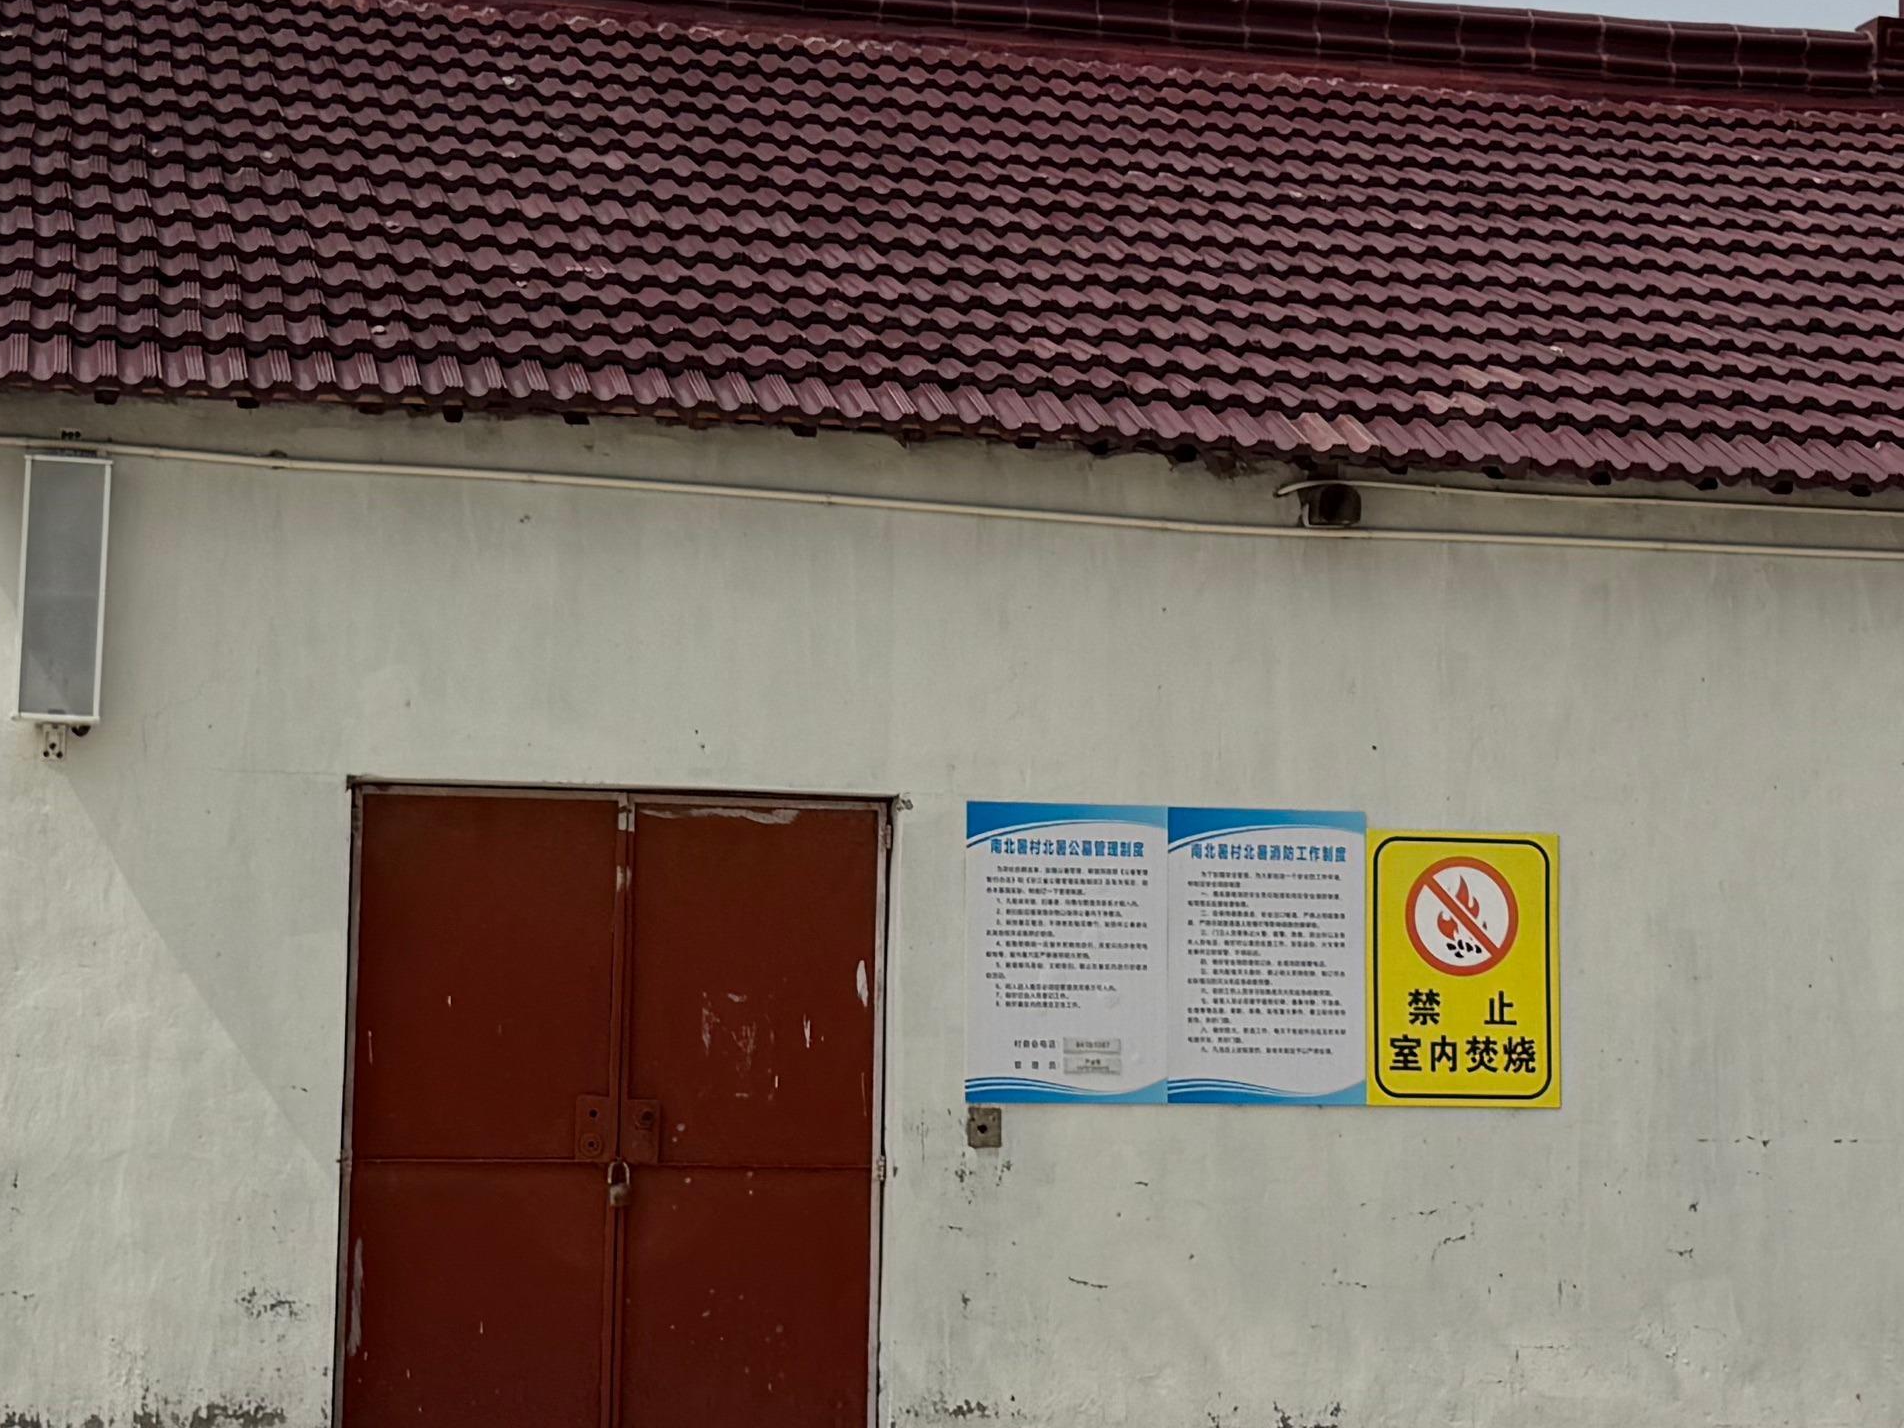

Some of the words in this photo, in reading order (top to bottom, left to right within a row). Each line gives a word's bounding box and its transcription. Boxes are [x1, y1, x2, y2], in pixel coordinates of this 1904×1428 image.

[1408, 988, 1517, 1026] 禁止
[1389, 1034, 1537, 1074] 室内焚烧
